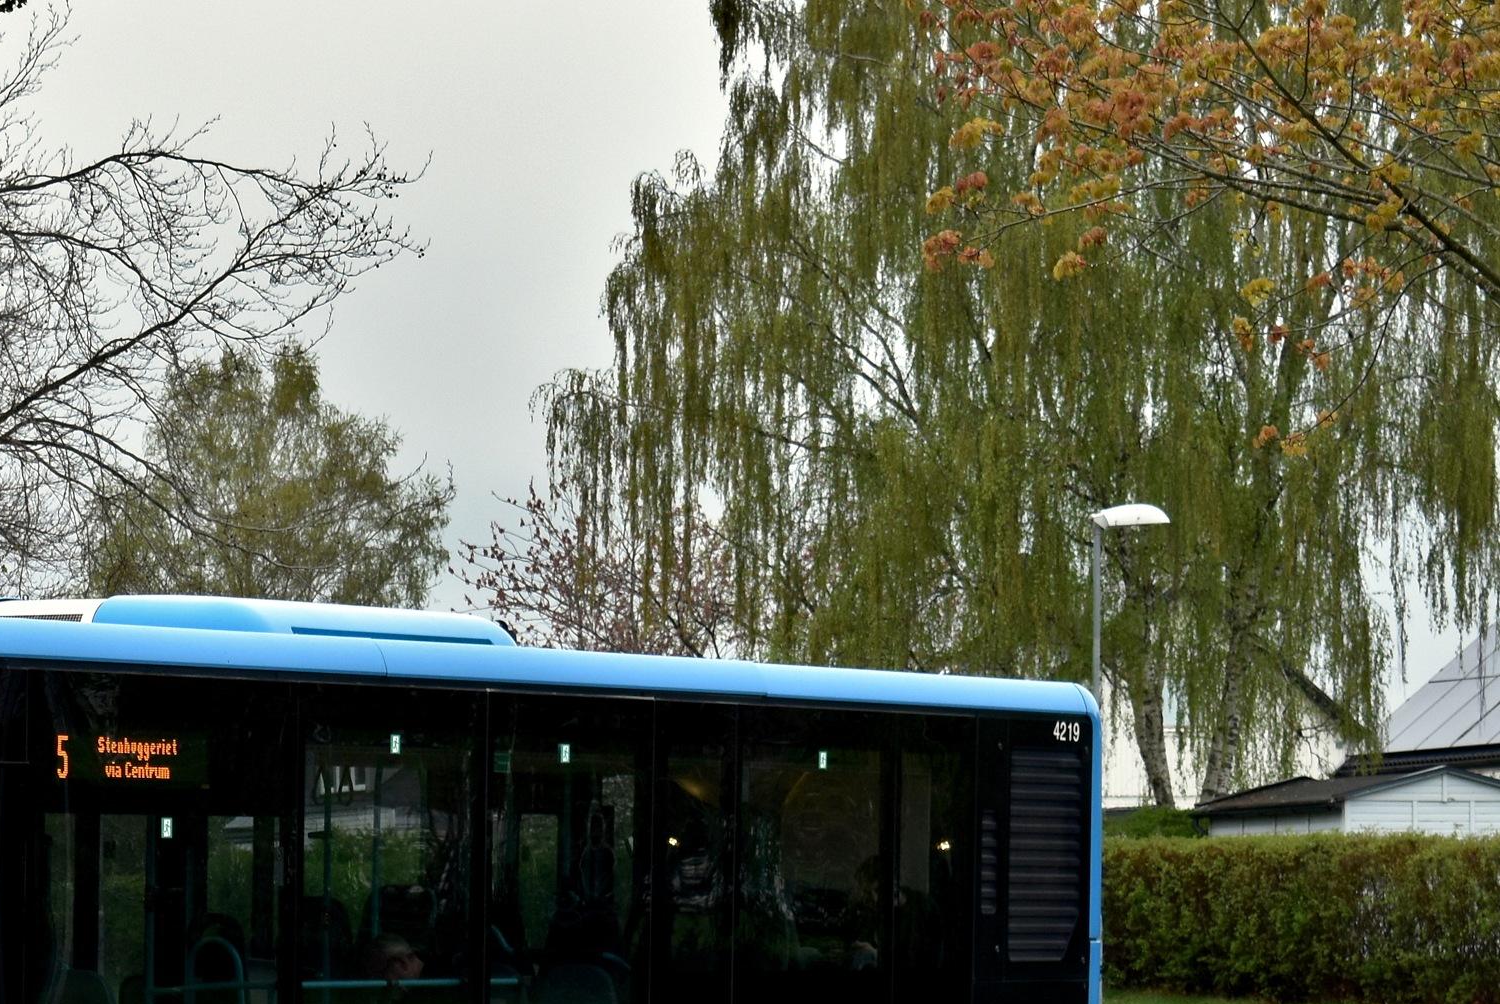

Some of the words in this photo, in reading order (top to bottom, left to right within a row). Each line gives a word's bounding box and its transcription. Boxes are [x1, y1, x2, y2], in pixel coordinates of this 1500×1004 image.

[1052, 720, 1080, 743] 4219
[56, 734, 69, 779] 5
[97, 736, 178, 761] Stenhuggeriet
[104, 761, 122, 778] via
[124, 761, 171, 779] Centrum
